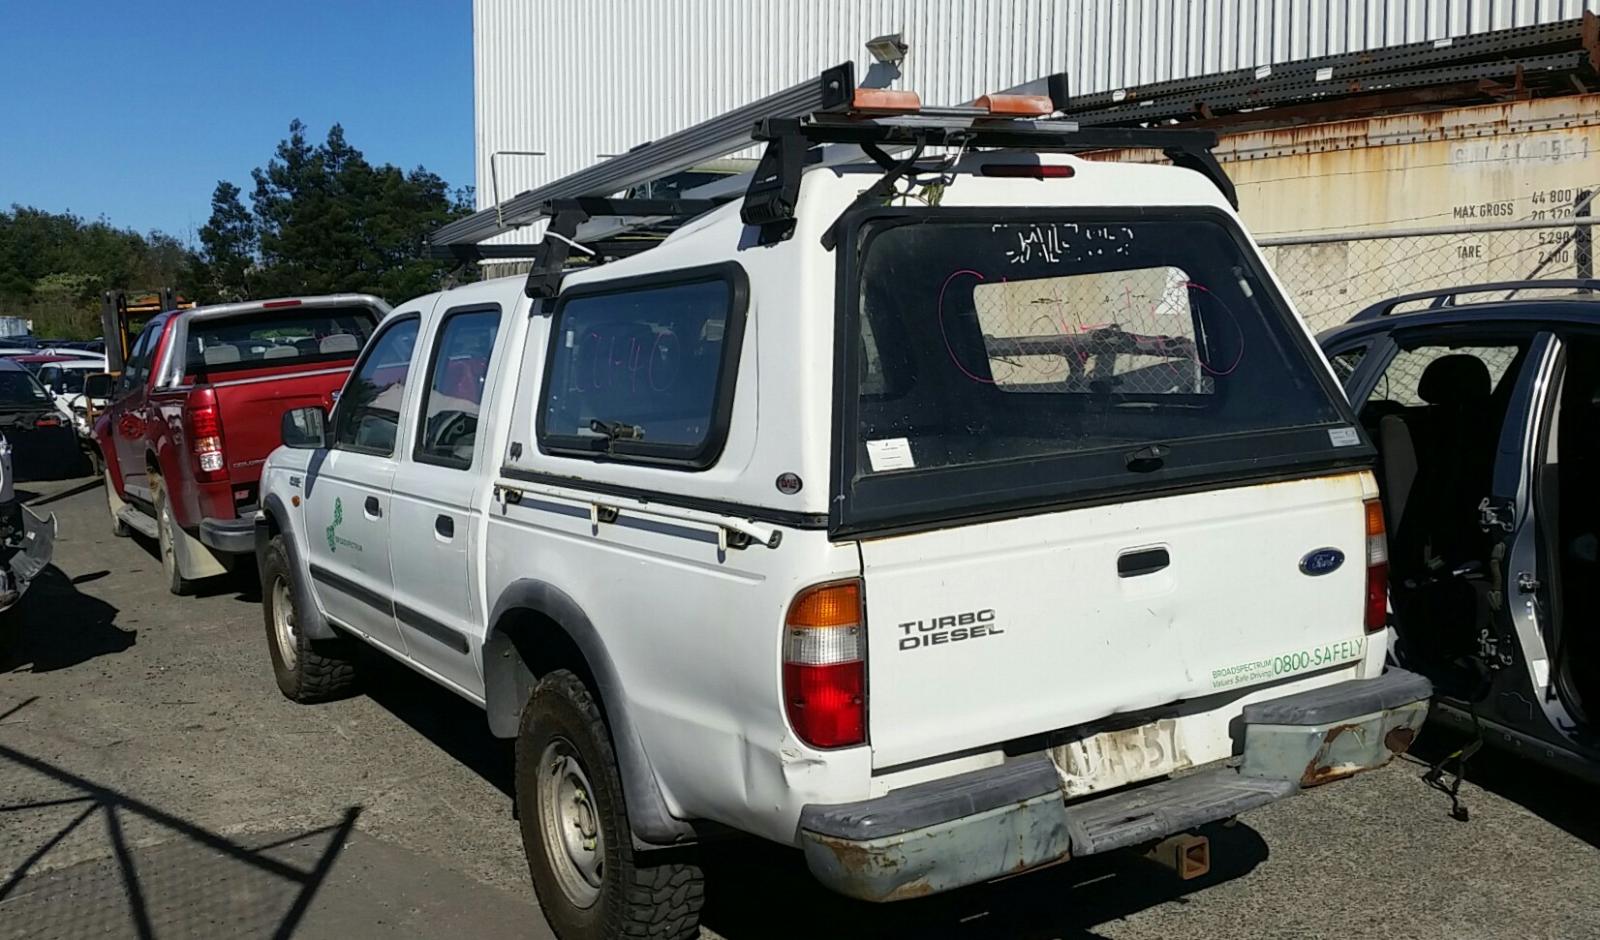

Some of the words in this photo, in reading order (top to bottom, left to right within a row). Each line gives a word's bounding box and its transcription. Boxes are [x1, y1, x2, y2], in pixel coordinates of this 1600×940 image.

[1532, 191, 1545, 204] 44
[1550, 189, 1571, 202] 800
[1480, 203, 1514, 217] GROSS
[1457, 245, 1482, 258] TARE
[898, 608, 996, 636] TURBO
[898, 623, 1005, 652] DIESEL
[1274, 638, 1363, 675] 0800-SAFELY
[1212, 659, 1271, 679] BROADSPECTRUM
